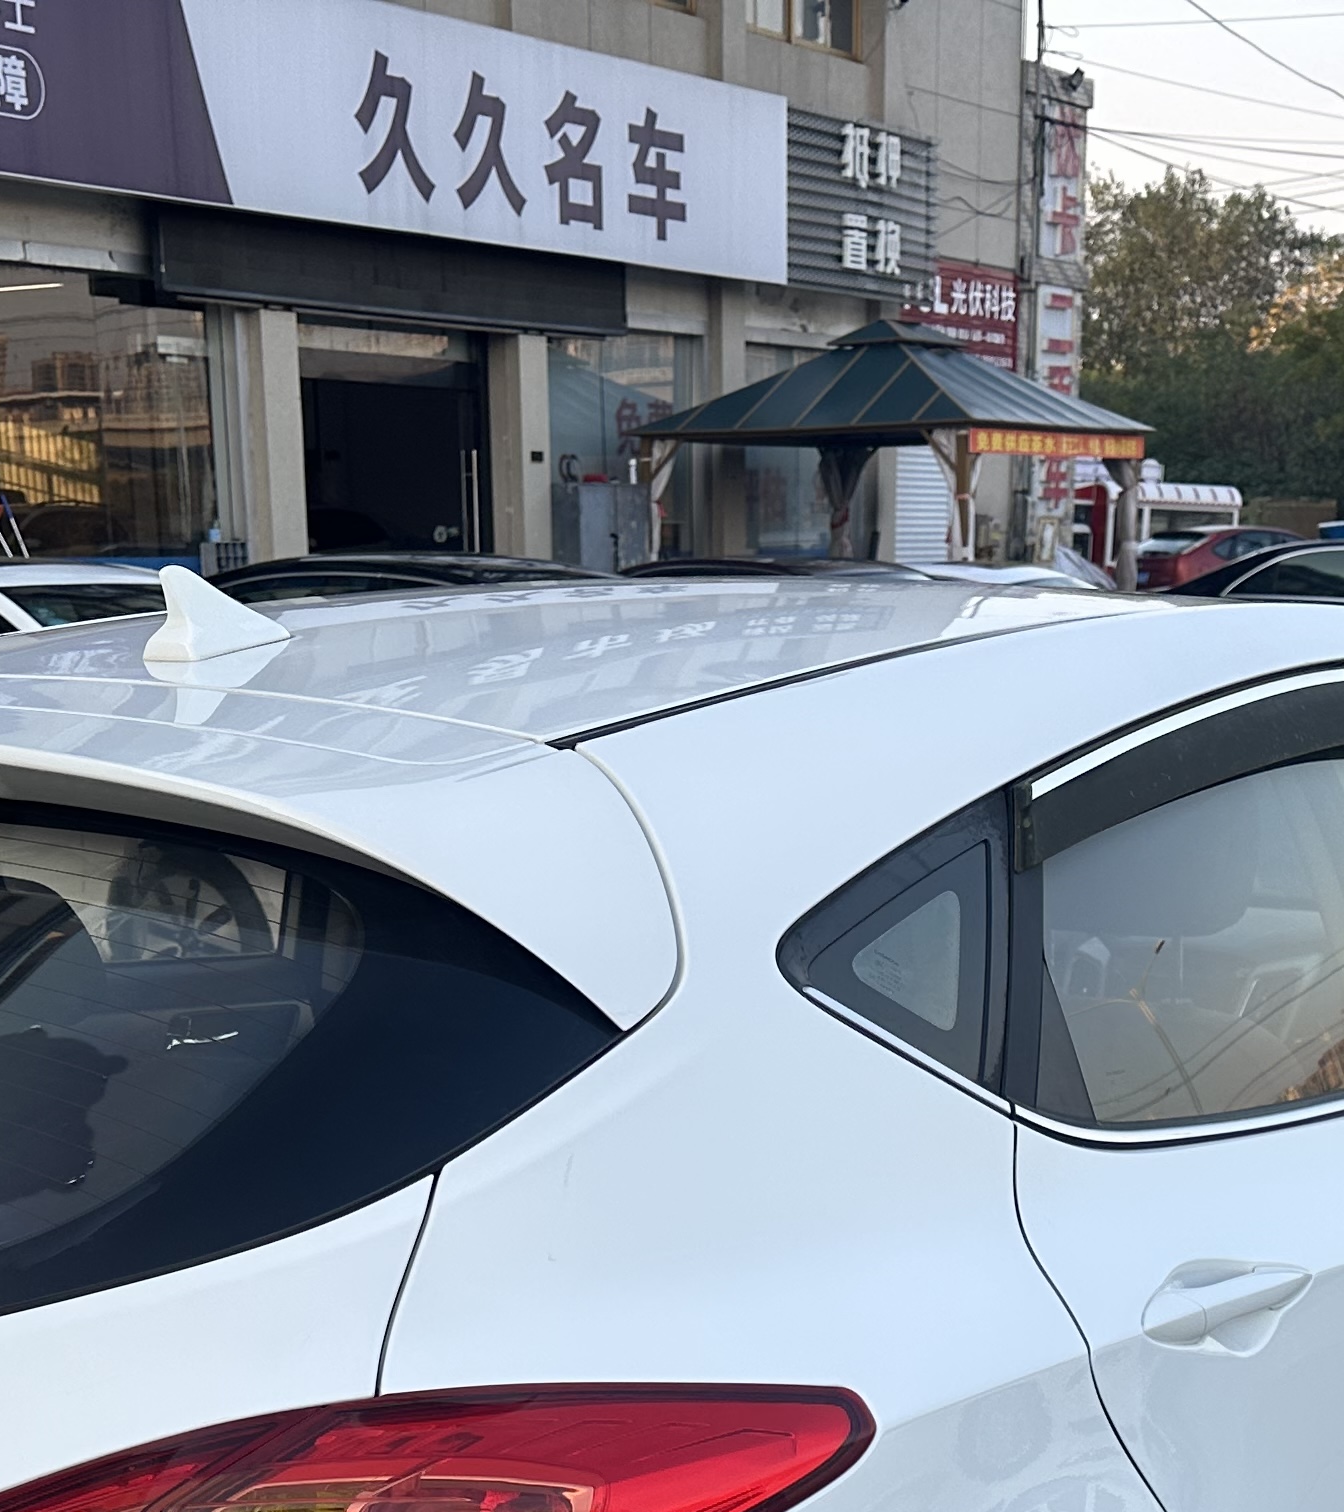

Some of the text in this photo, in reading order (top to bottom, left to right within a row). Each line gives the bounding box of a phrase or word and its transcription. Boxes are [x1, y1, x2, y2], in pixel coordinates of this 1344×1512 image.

[354, 49, 687, 241] 久久名车
[840, 122, 902, 189] 抵押
[841, 213, 901, 276] 置换
